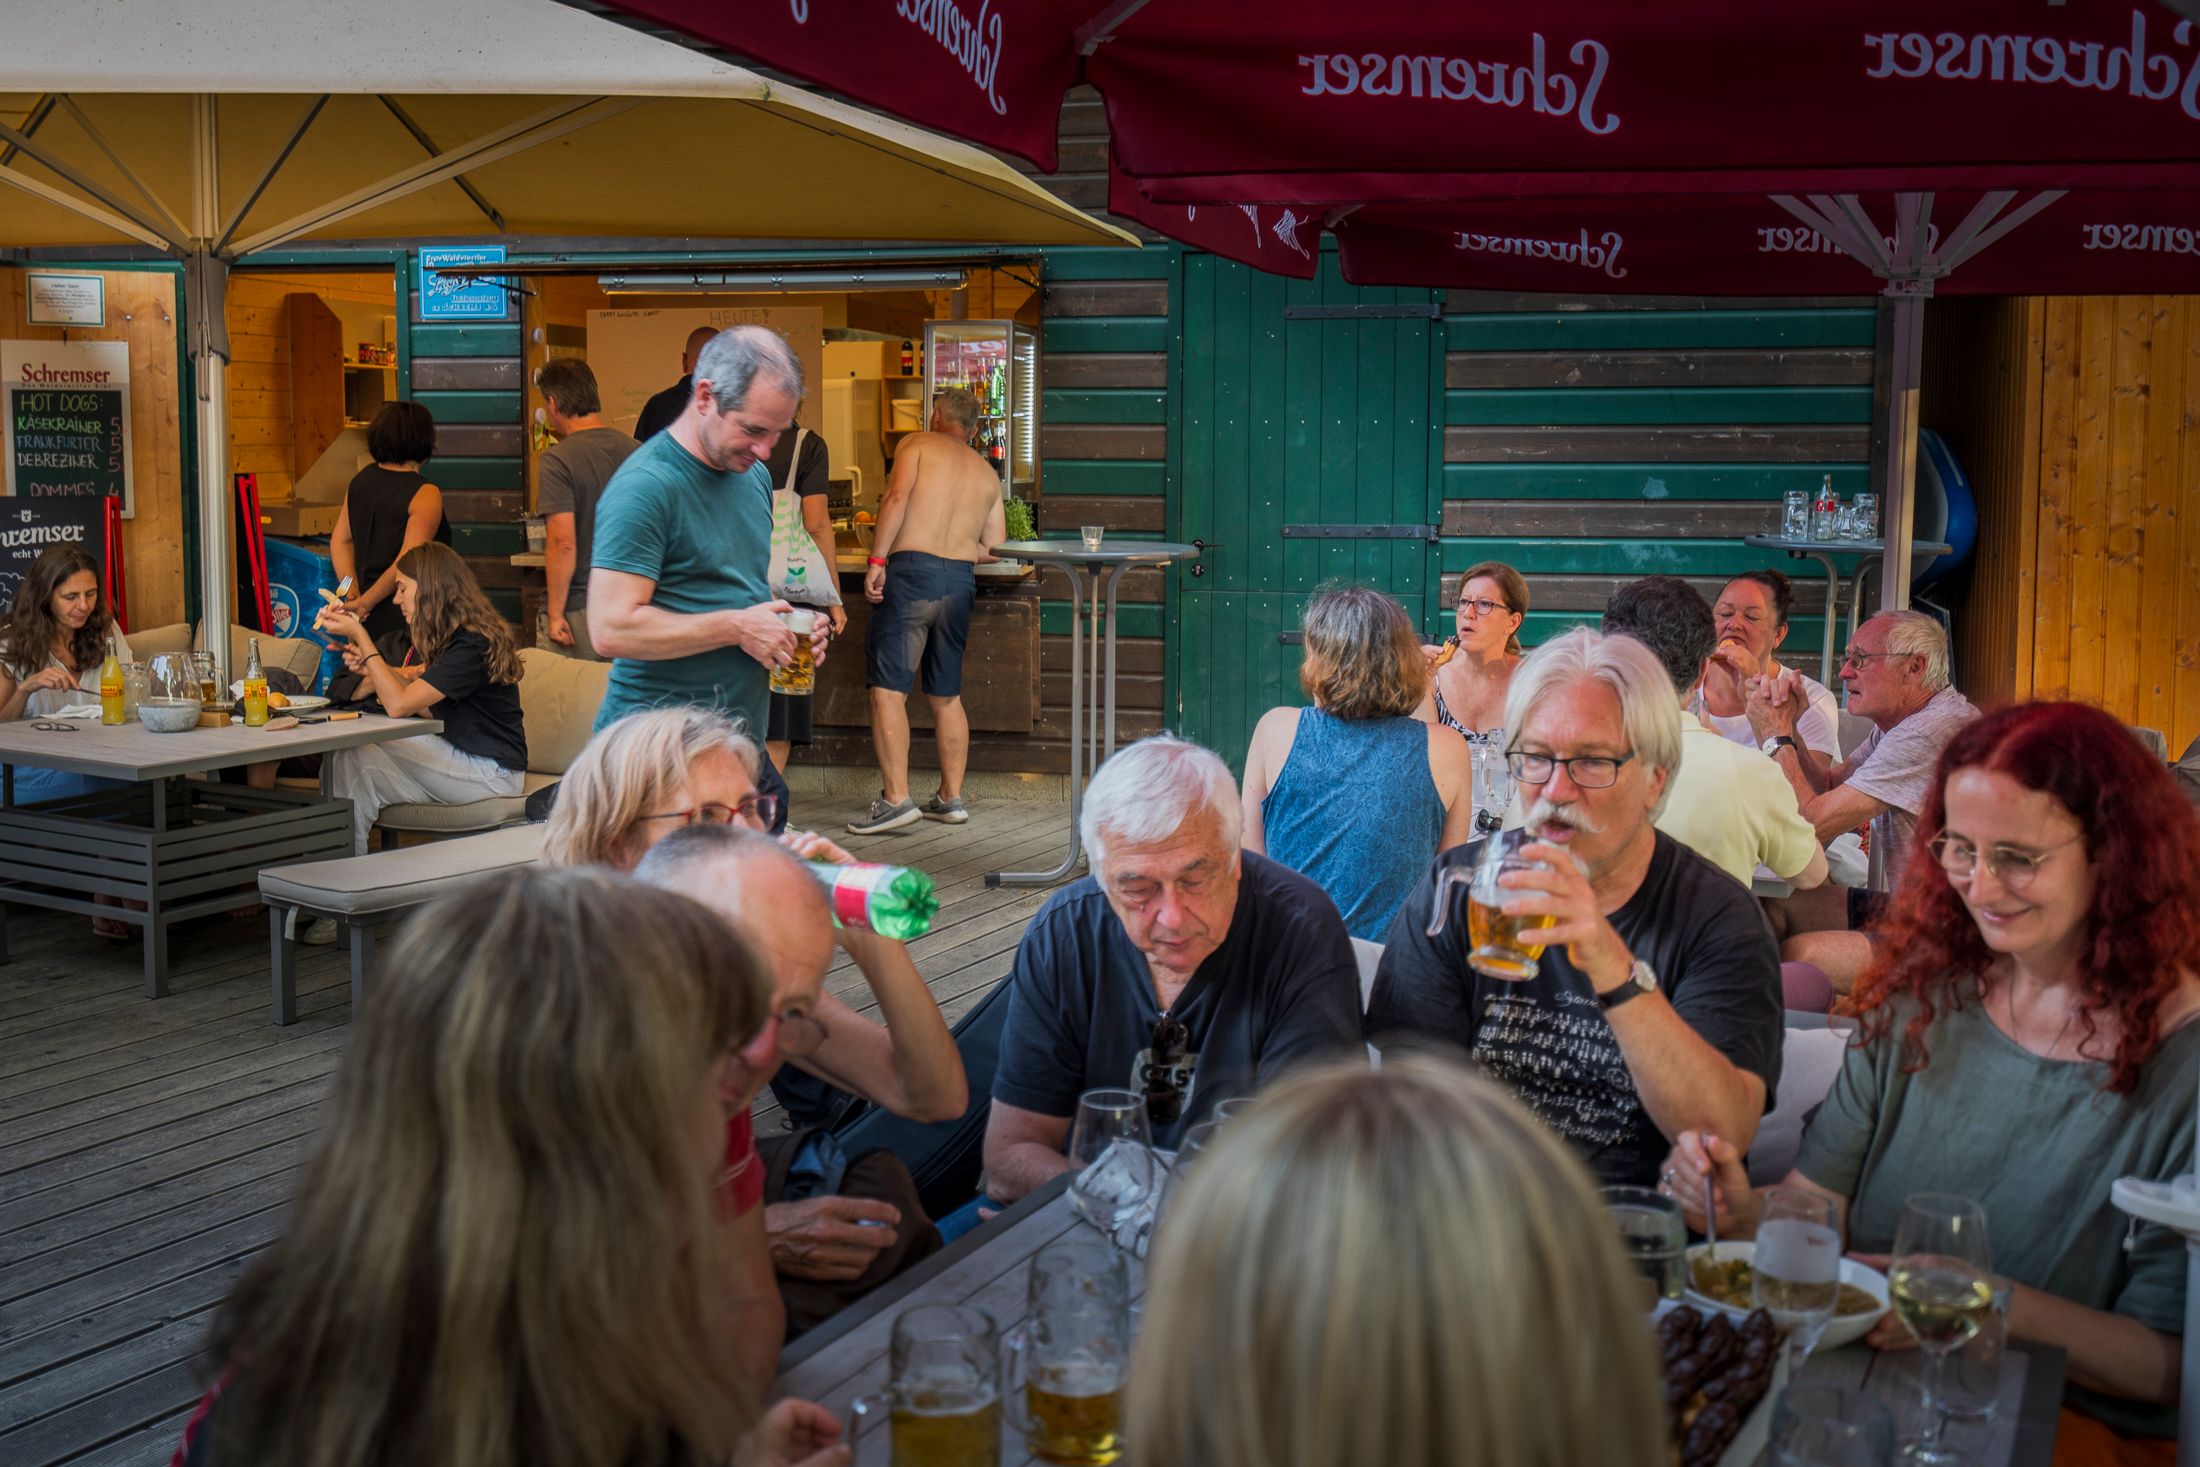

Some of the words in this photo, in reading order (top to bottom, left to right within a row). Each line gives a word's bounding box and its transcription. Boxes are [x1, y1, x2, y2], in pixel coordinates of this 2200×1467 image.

[21, 363, 111, 383] Schremser
[20, 394, 54, 412] HOT
[17, 434, 102, 453] FRANKFURTER
[17, 452, 99, 470] DEBREZINER
[12, 549, 31, 559] echt
